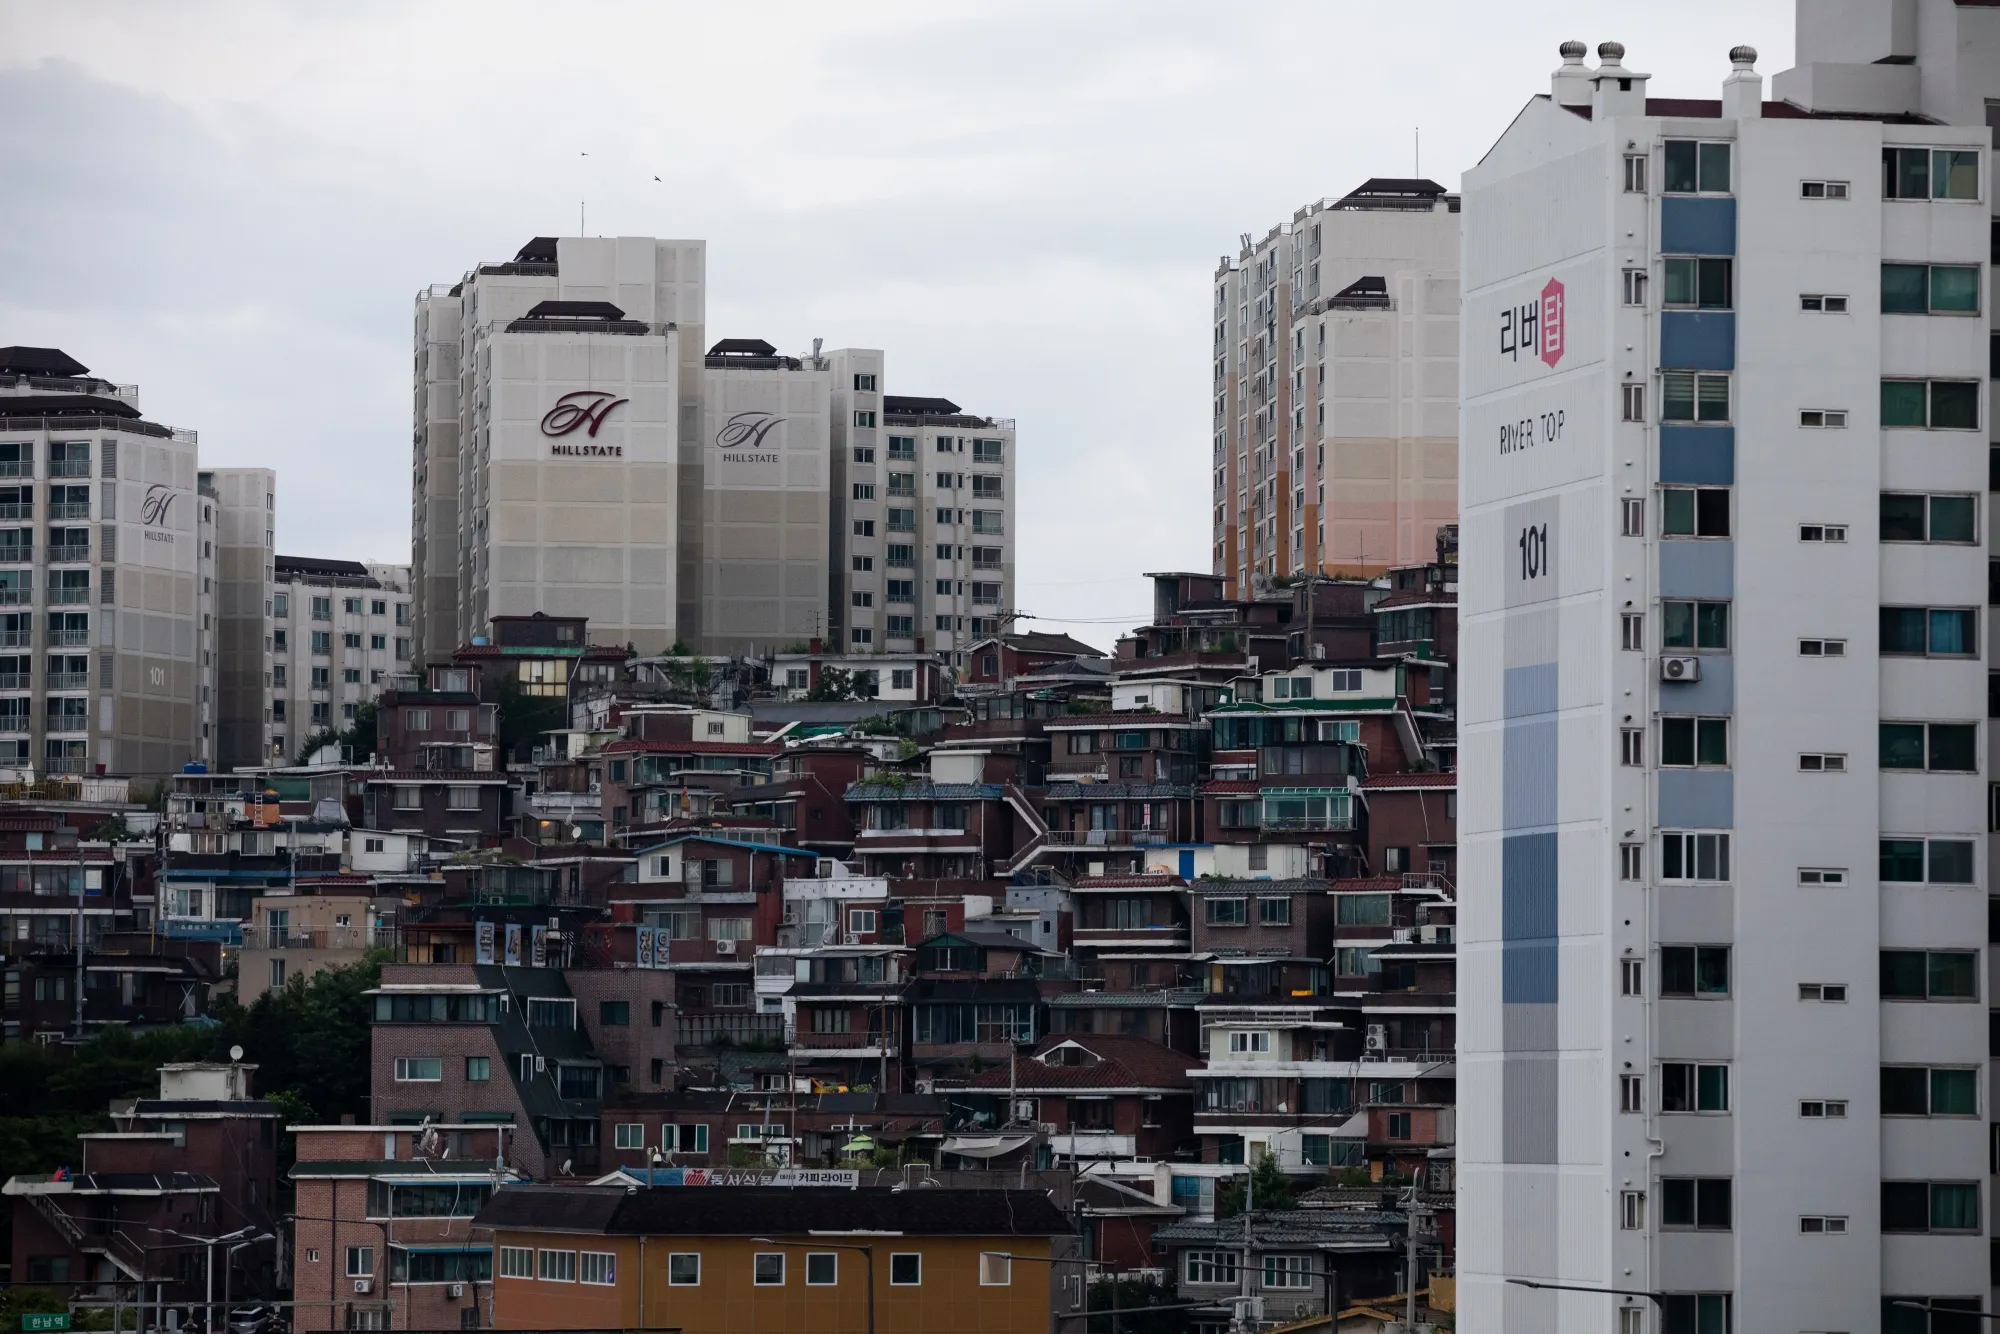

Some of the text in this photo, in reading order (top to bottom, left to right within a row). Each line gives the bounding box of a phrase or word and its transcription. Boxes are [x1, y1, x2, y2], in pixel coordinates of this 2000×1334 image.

[1500, 292, 1564, 362] 리버탑
[1500, 409, 1566, 456] RIVER TOP
[551, 444, 622, 457] HILLSTATE
[723, 452, 779, 464] HILLSTATE
[144, 530, 174, 544] HILLSTATE
[1519, 522, 1547, 581] 101
[150, 666, 164, 685] 101
[710, 1174, 773, 1186] 동서식품
[798, 1172, 854, 1183] 커피라이프
[32, 1316, 64, 1328] 한남역
